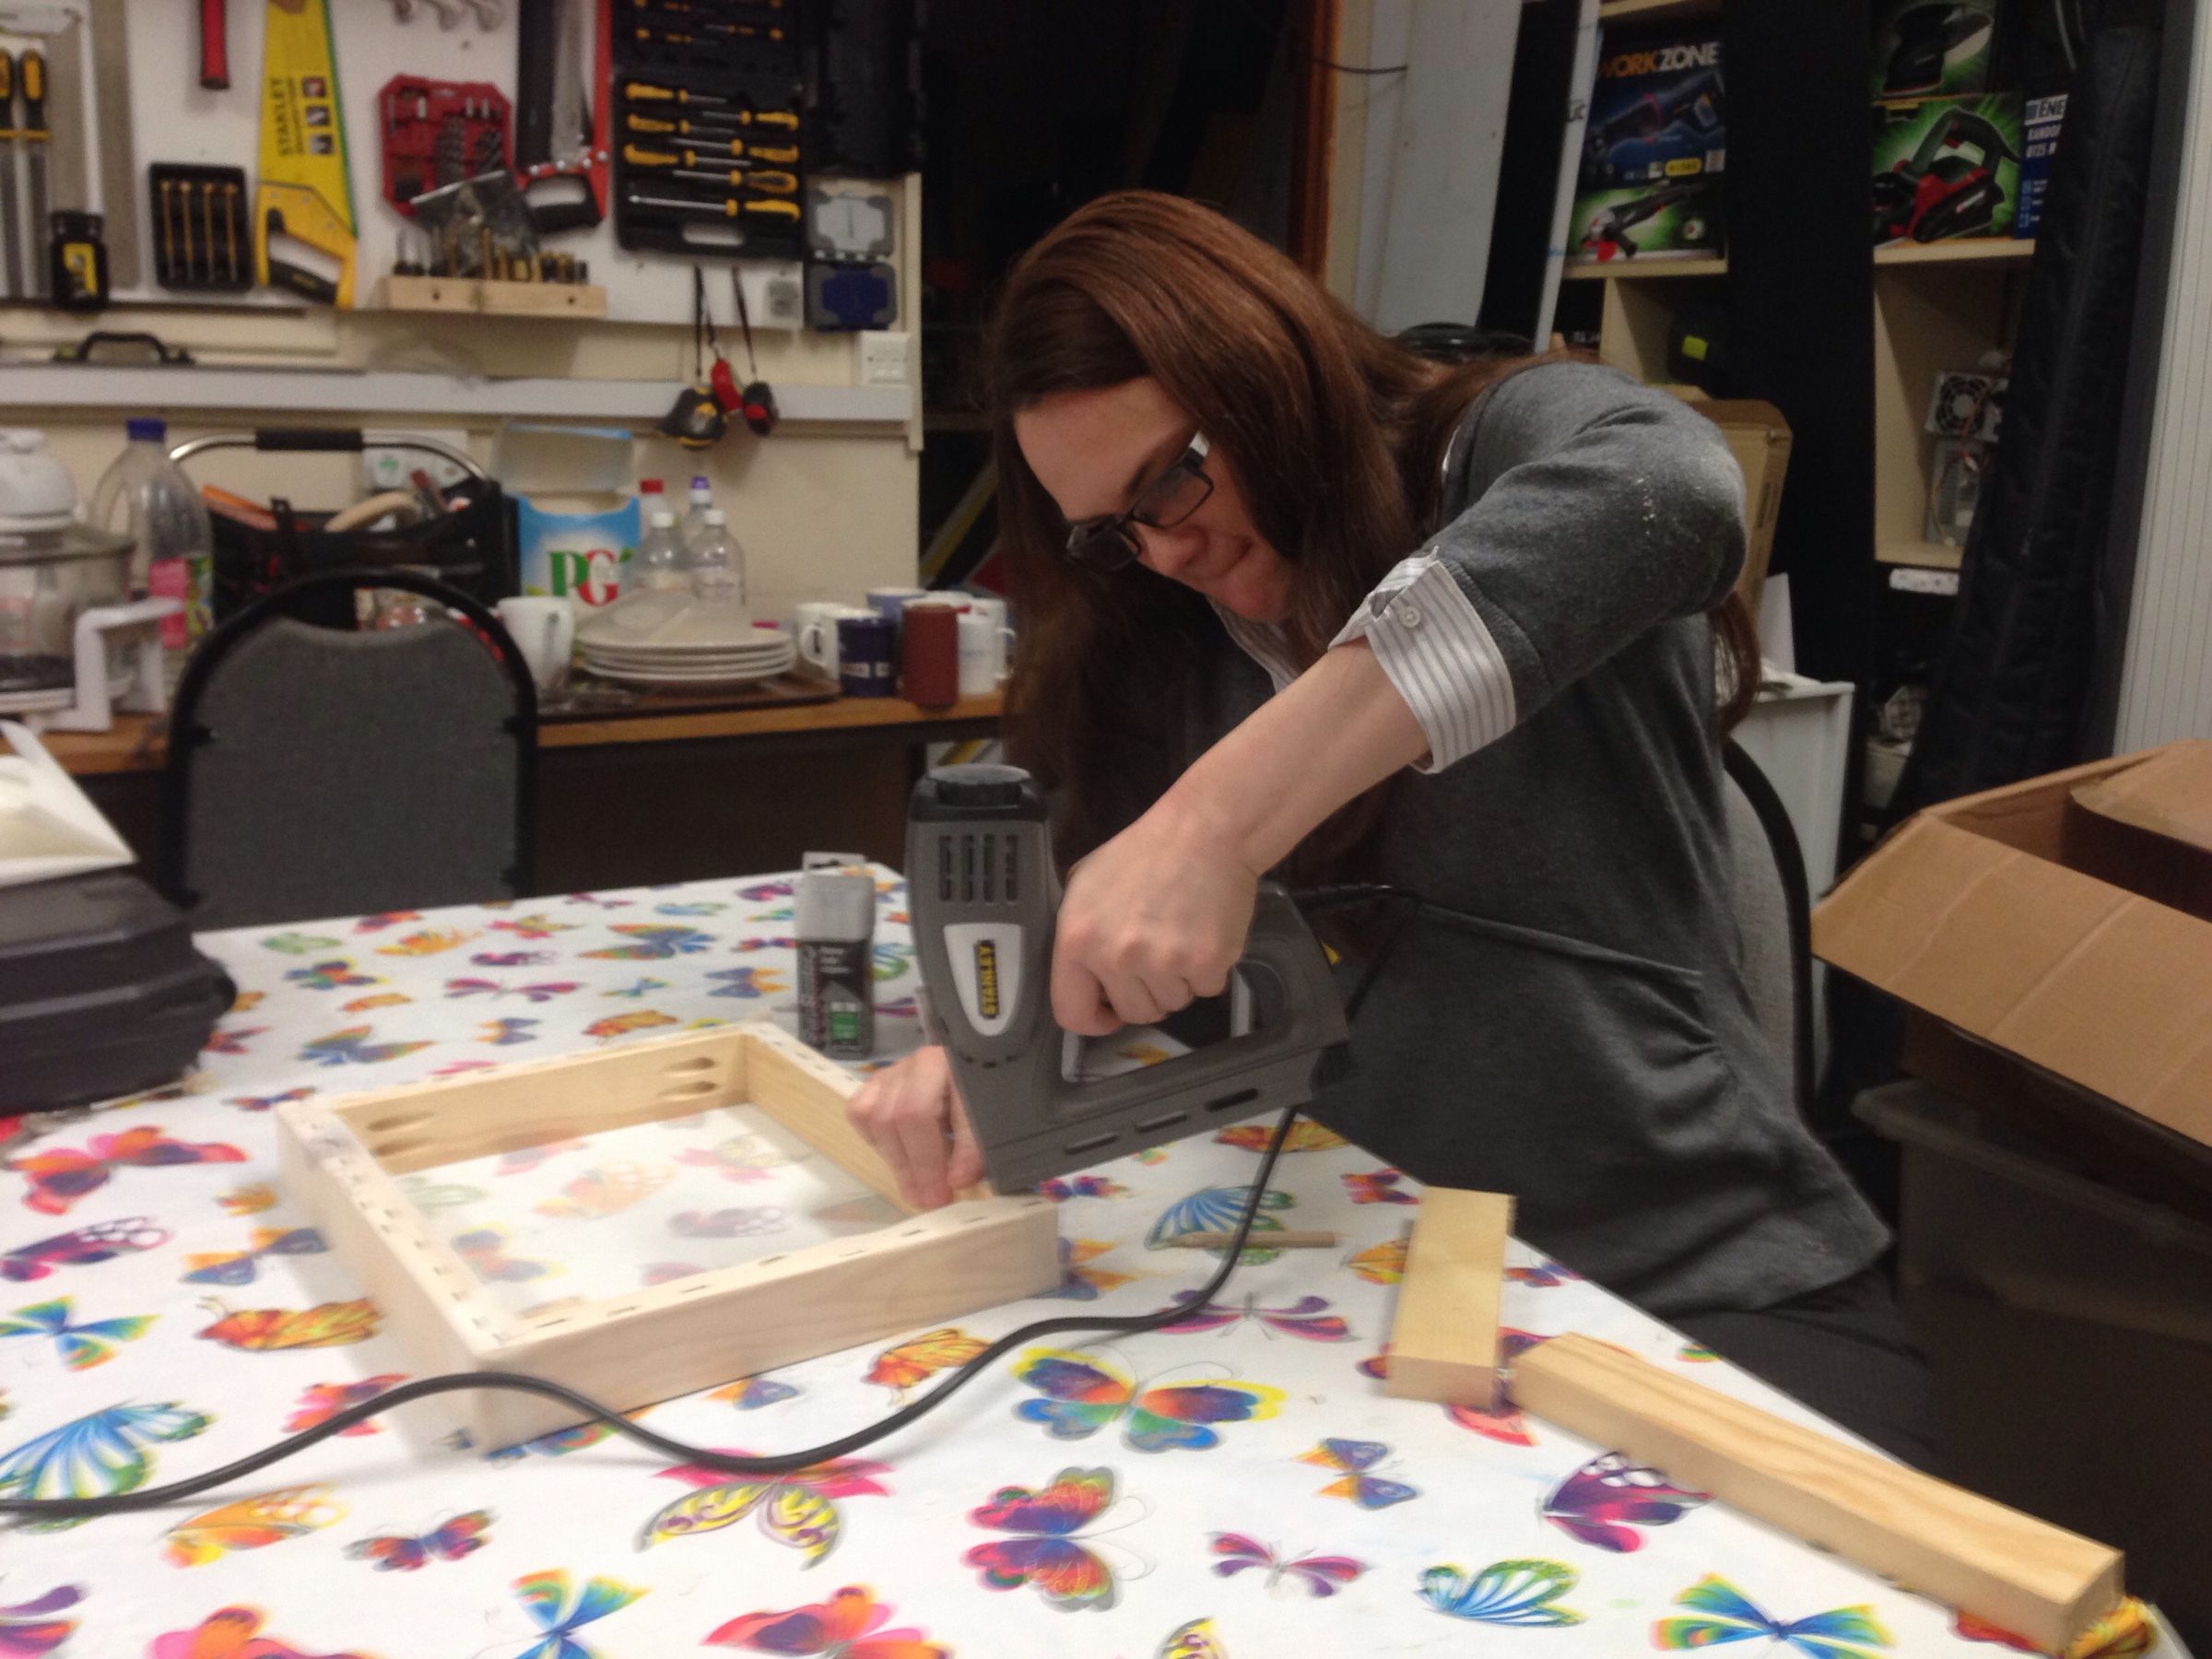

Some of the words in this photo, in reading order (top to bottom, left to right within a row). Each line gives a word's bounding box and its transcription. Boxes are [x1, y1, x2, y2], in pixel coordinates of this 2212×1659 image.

[270, 77, 293, 155] STANLEY
[549, 548, 619, 606] PG
[978, 943, 997, 1016] STANLEY
